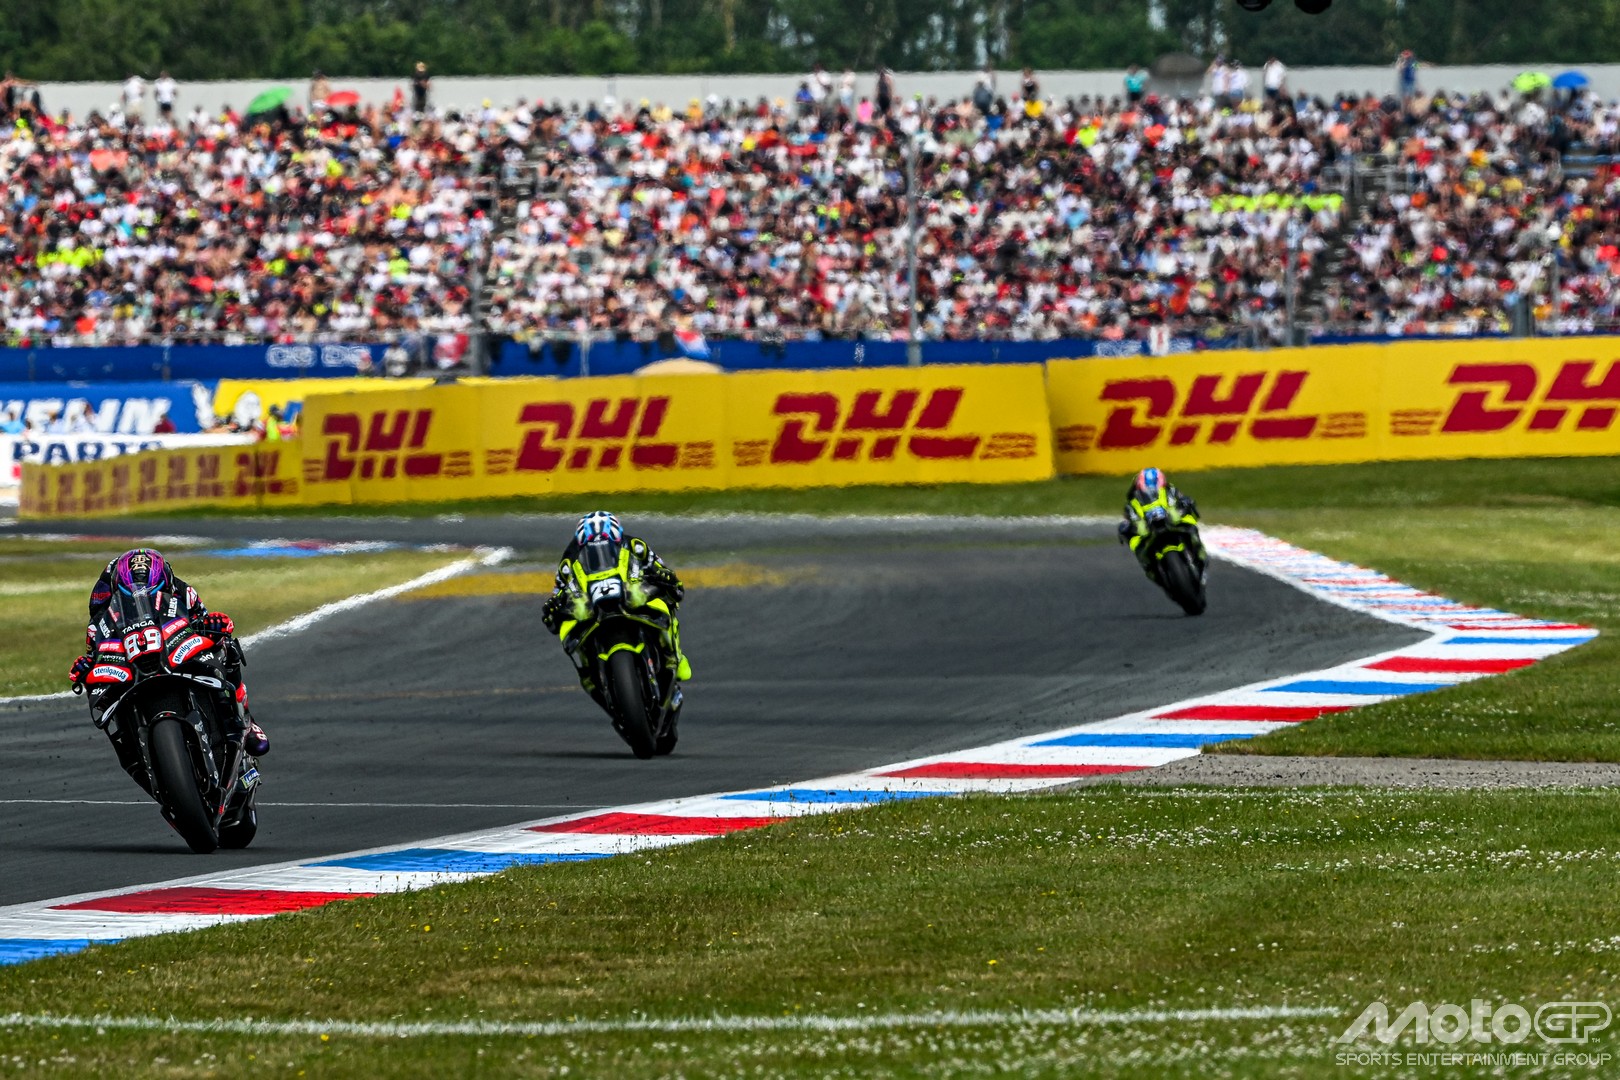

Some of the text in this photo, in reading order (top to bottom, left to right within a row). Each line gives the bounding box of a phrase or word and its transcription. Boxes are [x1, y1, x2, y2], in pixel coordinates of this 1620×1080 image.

[1097, 370, 1319, 450] DHL
[1440, 361, 1620, 433] DH
[515, 396, 680, 471] DHL
[769, 387, 981, 465] DHL
[322, 408, 442, 480] DHL
[122, 620, 155, 634] TARGA
[124, 628, 162, 661] 89
[174, 637, 202, 662] sterilgarda
[199, 652, 215, 662] sky
[94, 667, 127, 680] sterilgarda
[91, 688, 107, 696] sky
